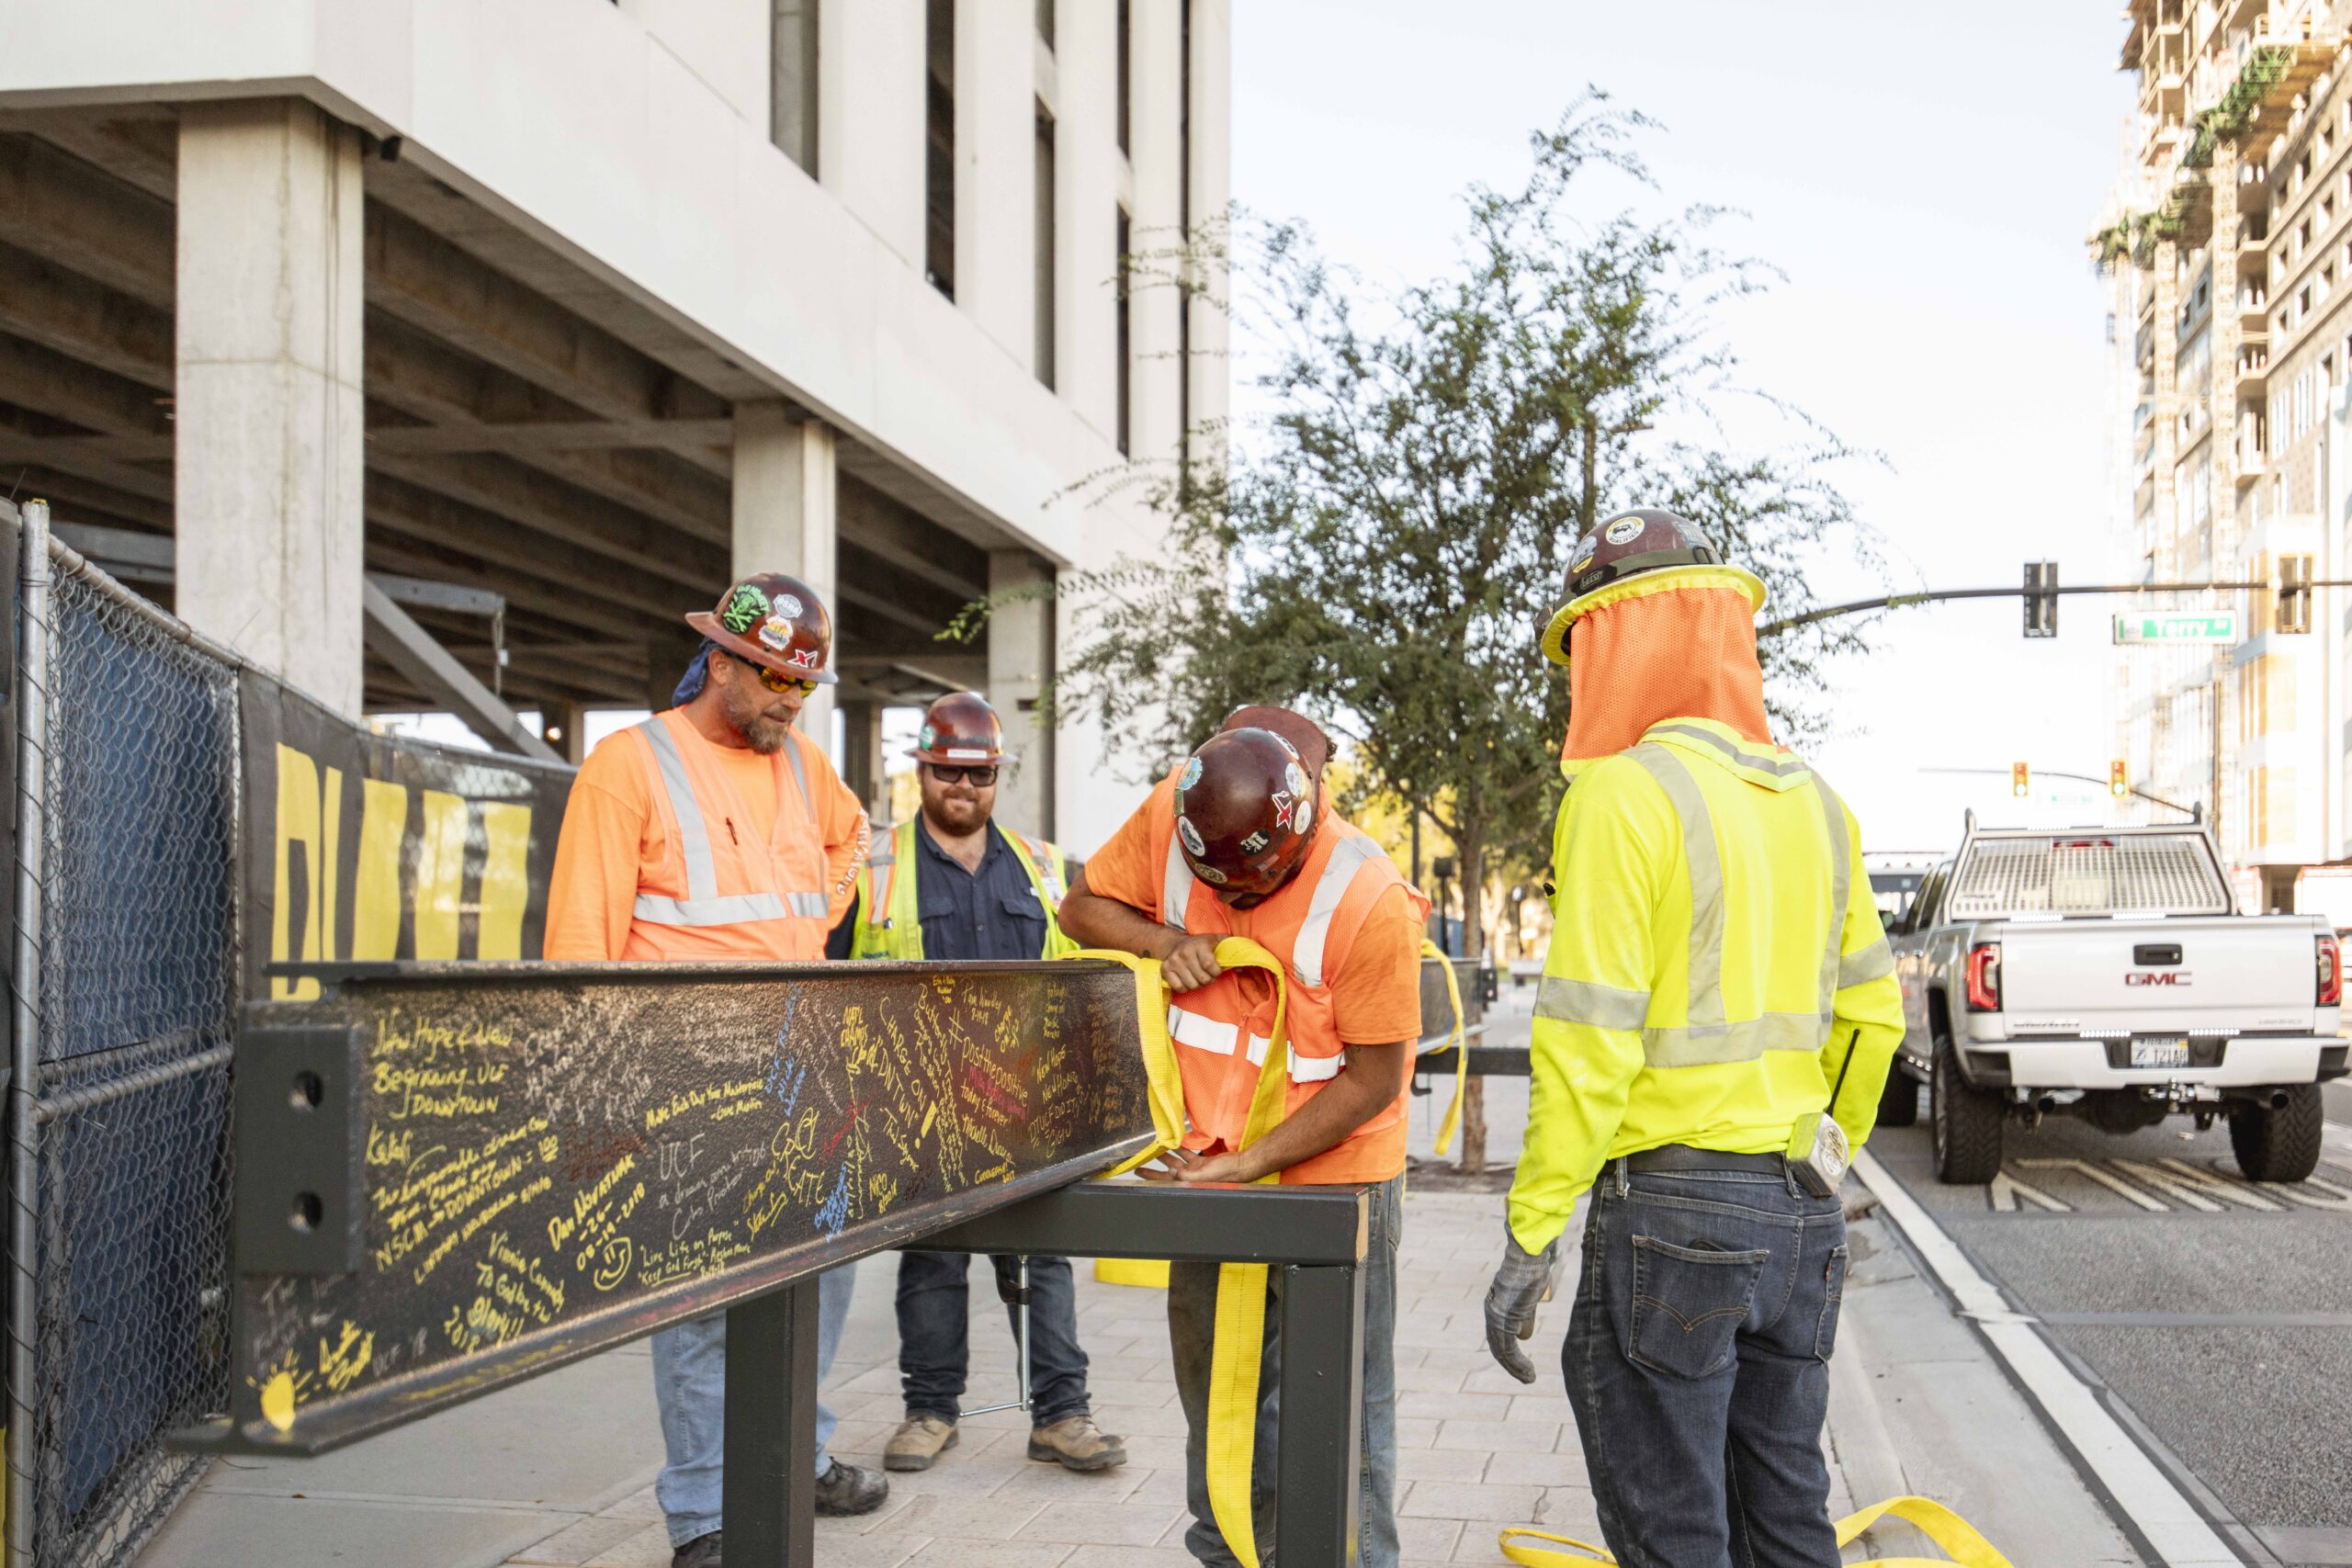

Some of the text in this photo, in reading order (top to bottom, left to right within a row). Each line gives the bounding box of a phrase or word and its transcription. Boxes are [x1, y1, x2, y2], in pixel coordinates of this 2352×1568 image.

[1609, 530, 1639, 544] QUALIFIED
[2125, 972, 2192, 986] GMC
[411, 1015, 455, 1063] Hope
[878, 996, 912, 1077] CHARGE
[960, 1077, 980, 1114] today
[659, 1132, 705, 1181] UCF
